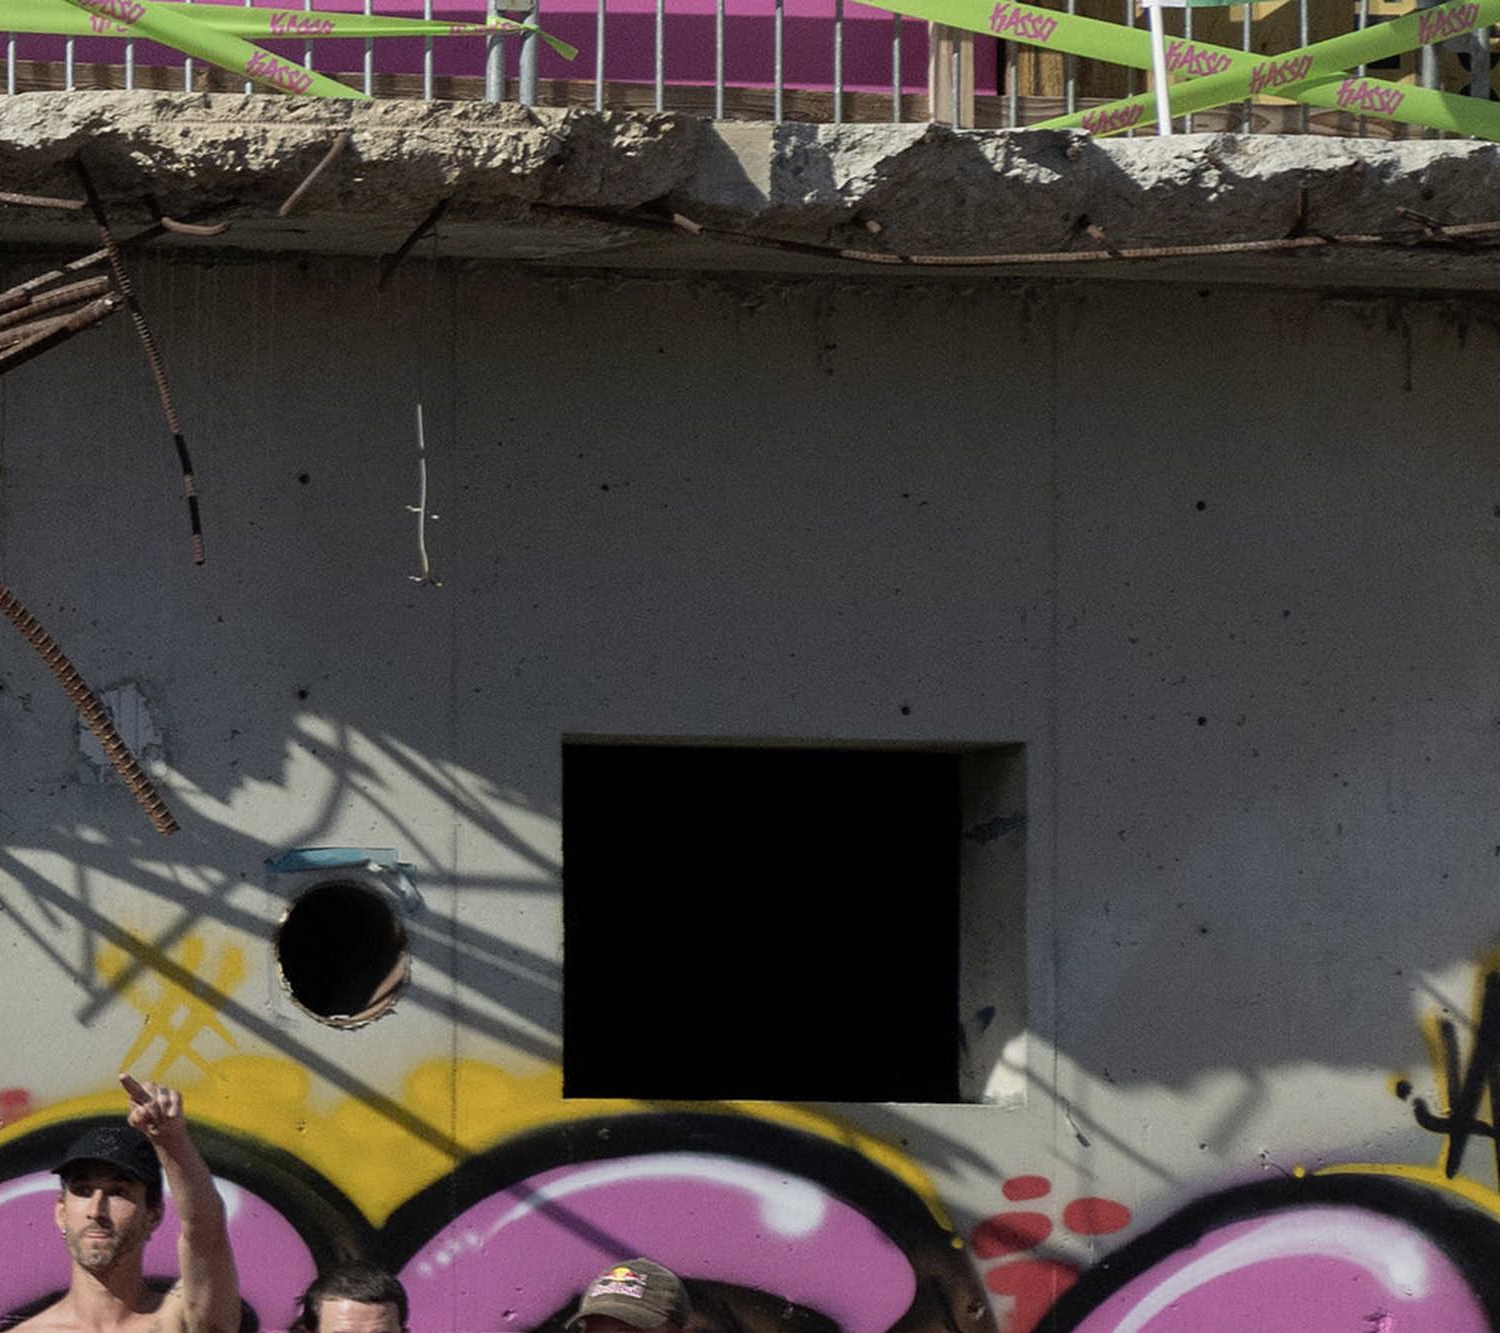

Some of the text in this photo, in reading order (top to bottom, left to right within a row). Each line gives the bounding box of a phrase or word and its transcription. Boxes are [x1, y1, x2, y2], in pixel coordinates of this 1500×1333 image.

[989, 5, 1059, 42] KASSO
[1418, 3, 1480, 44] KASSO
[244, 50, 314, 94] KASSO
[1165, 40, 1232, 77] KASSO
[1250, 55, 1314, 94] KASSO
[1335, 77, 1404, 116] KASSO
